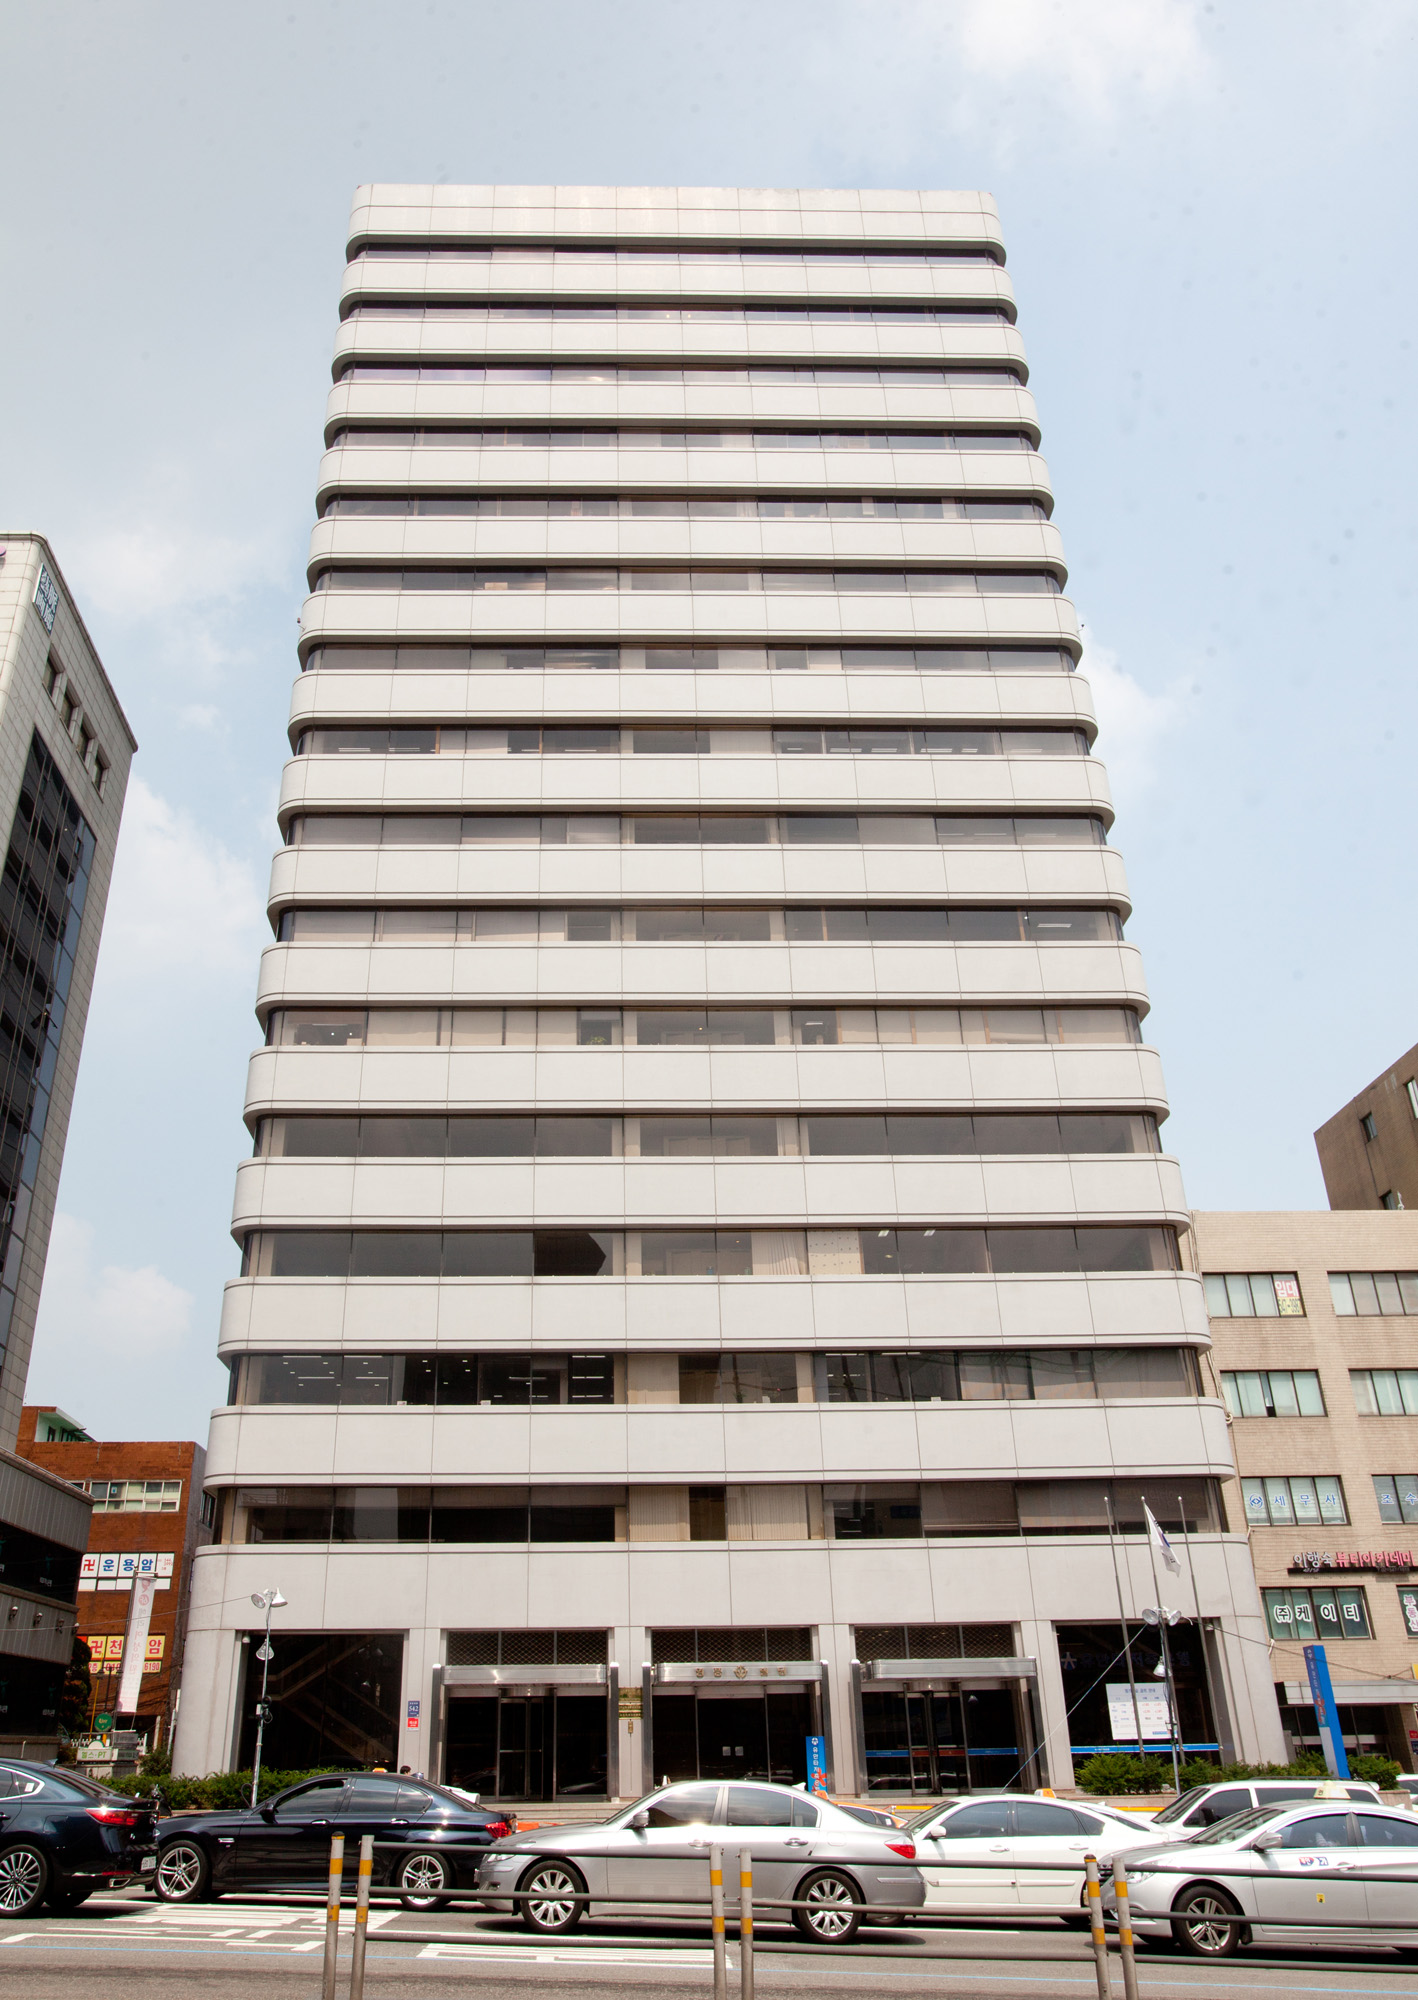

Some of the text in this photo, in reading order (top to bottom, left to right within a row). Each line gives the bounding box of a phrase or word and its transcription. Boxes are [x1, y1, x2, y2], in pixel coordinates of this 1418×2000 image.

[1275, 1280, 1299, 1297] 임대
[1274, 1494, 1337, 1507] 세무사
[102, 1558, 154, 1572] 운용암
